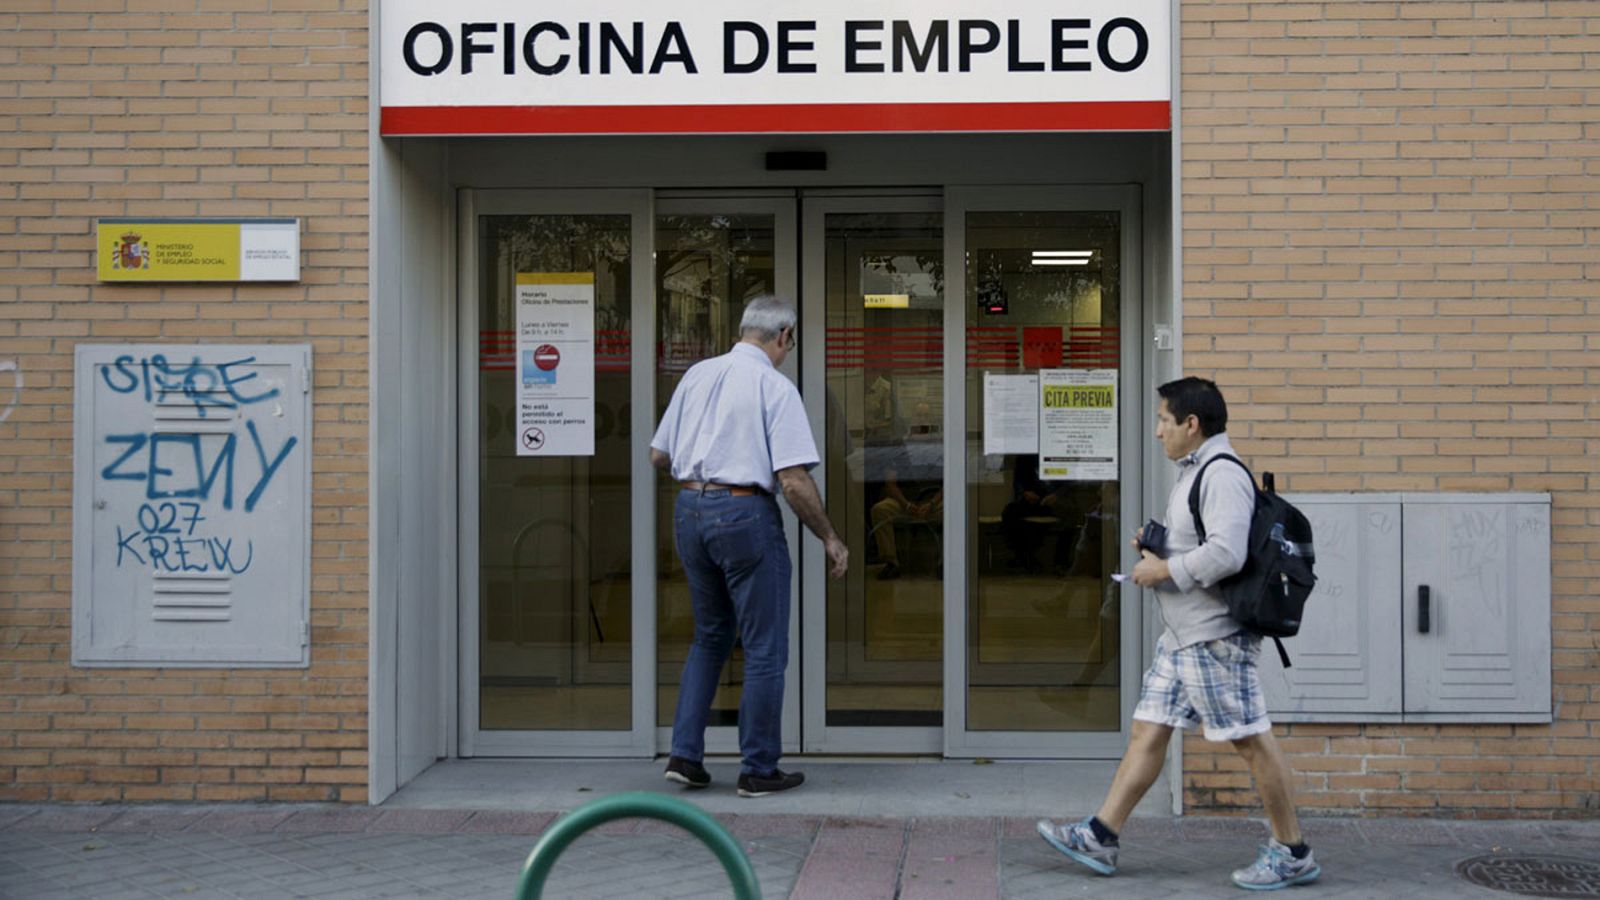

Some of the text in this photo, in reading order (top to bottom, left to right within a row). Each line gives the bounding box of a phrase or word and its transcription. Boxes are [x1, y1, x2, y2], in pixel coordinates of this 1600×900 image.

[403, 17, 1149, 76] OFICINA DE EMPLEO
[522, 411, 555, 419] permitido
[1045, 391, 1113, 408] CITA PREVIA
[137, 502, 206, 536] 027
[116, 525, 254, 575] KREW
